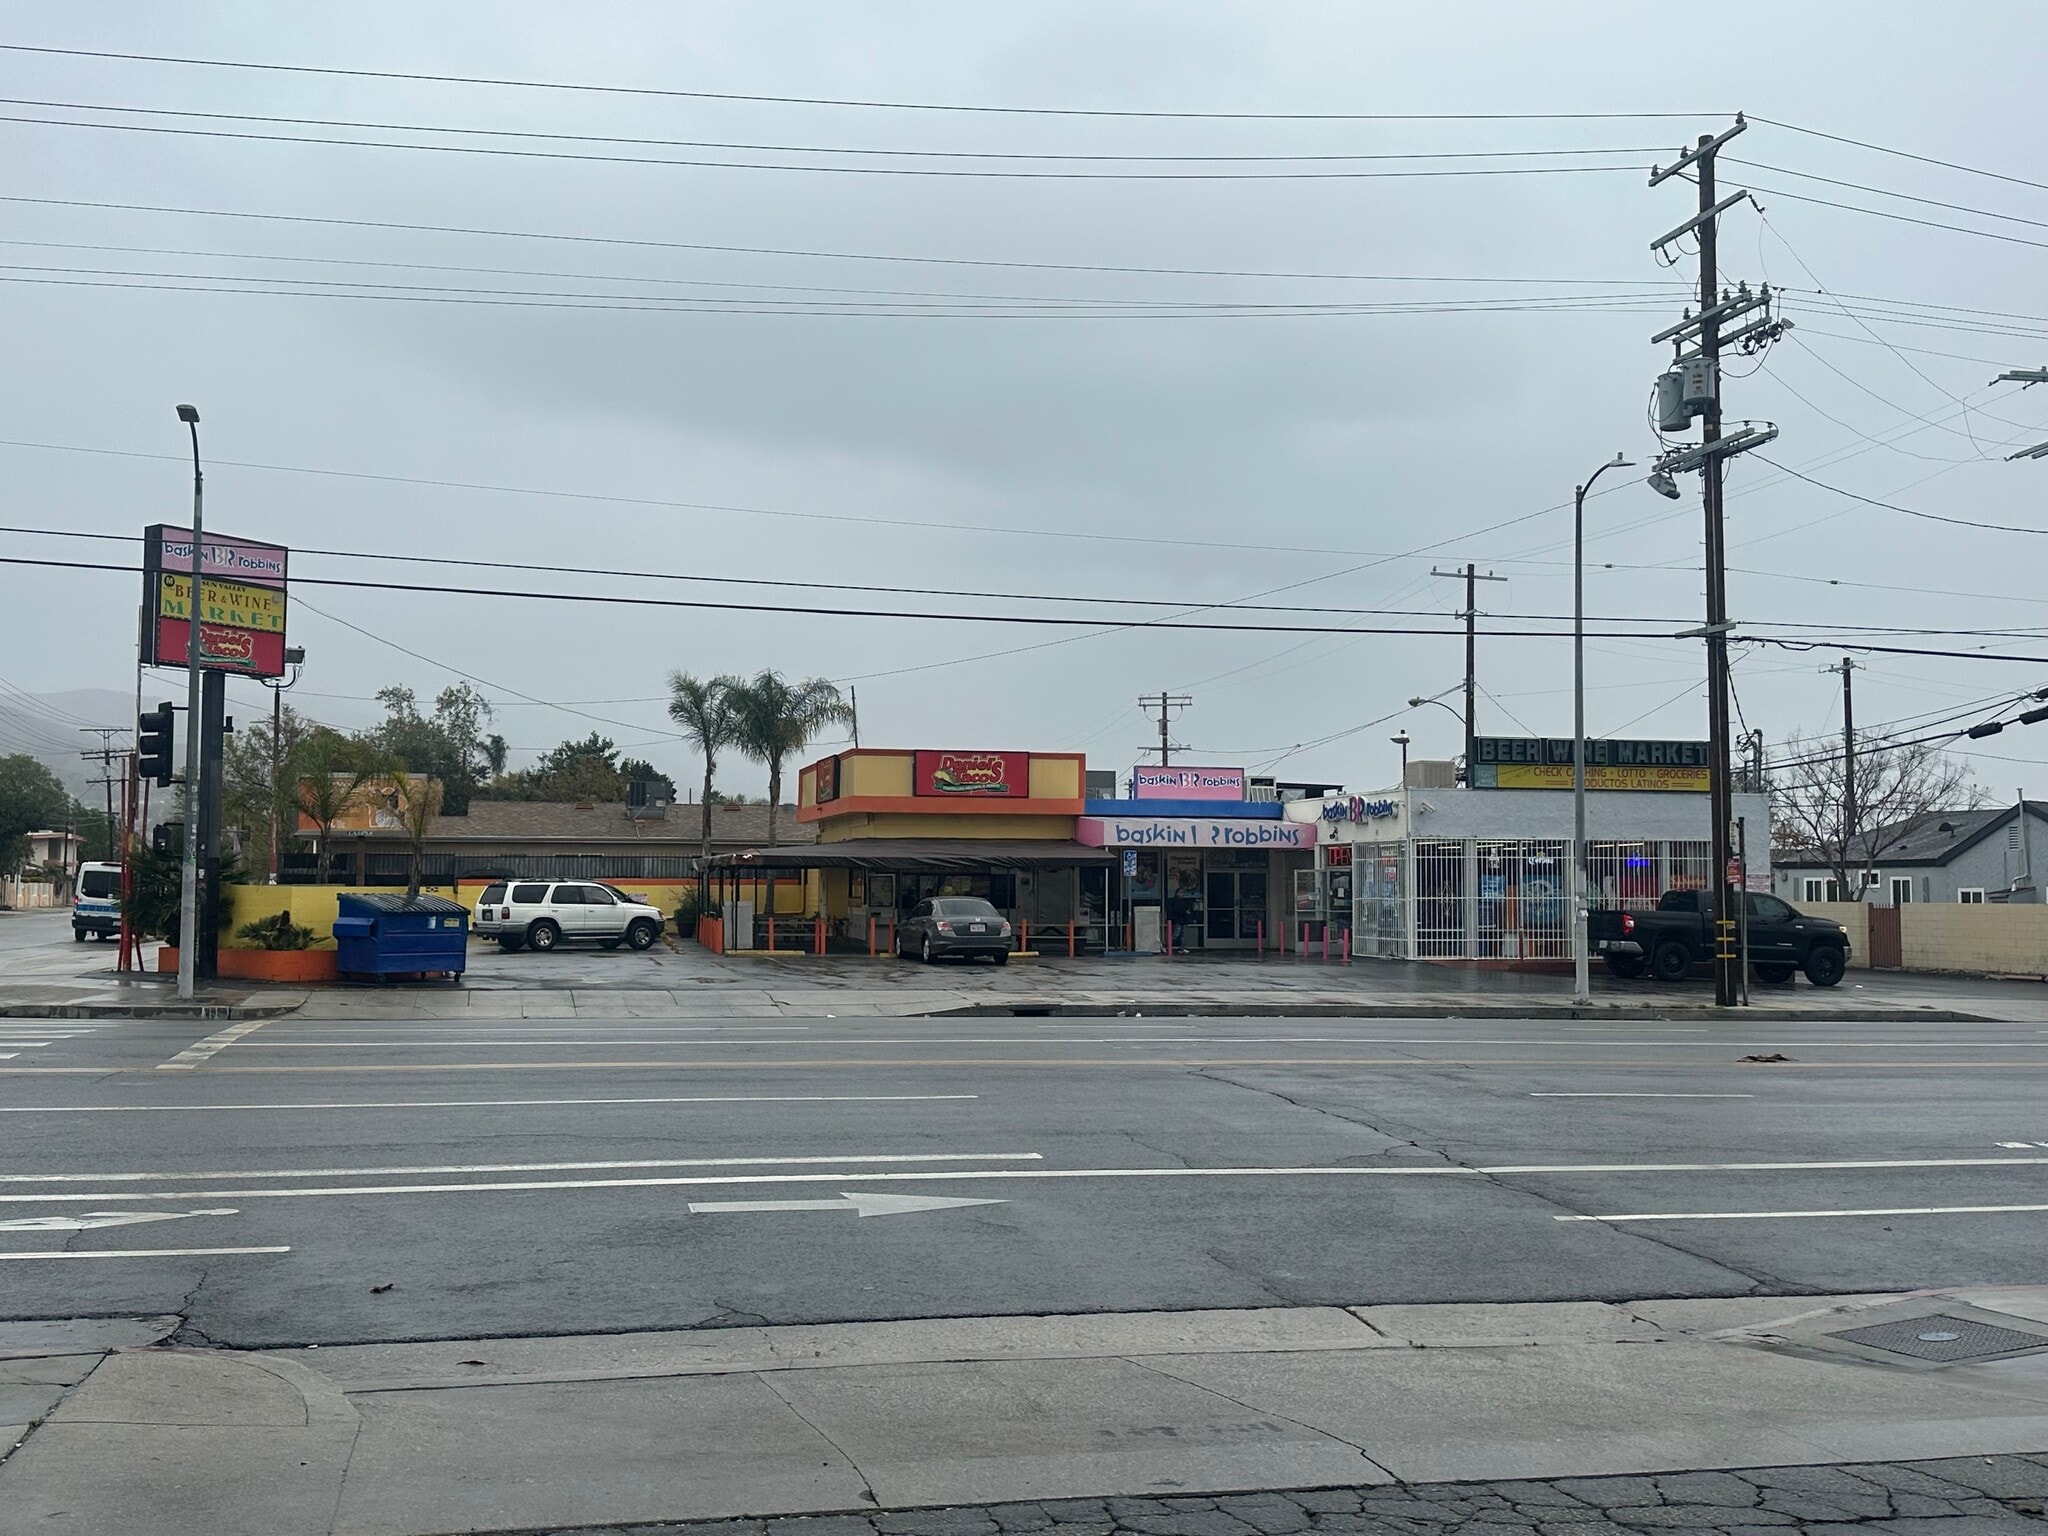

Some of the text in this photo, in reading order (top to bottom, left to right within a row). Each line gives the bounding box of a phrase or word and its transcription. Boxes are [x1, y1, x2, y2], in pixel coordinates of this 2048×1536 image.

[164, 542, 208, 561] baskn
[238, 555, 282, 573] robbins
[202, 580, 247, 593] SUN VALLEY
[229, 593, 271, 611] WINE
[164, 599, 282, 628] MRKET
[1480, 740, 1708, 765] BEER WNE MARKET
[1139, 774, 1177, 787] baskin
[1203, 776, 1240, 788] robbins
[1533, 766, 1563, 778] CHECK
[1566, 768, 1607, 779] CHING
[1617, 768, 1647, 779] LOTTO
[1657, 769, 1708, 780] GROCERIES
[1571, 778, 1669, 789] PODUCTOS LATINOS
[1116, 824, 1186, 845] baskin
[1225, 824, 1300, 846] robbins
